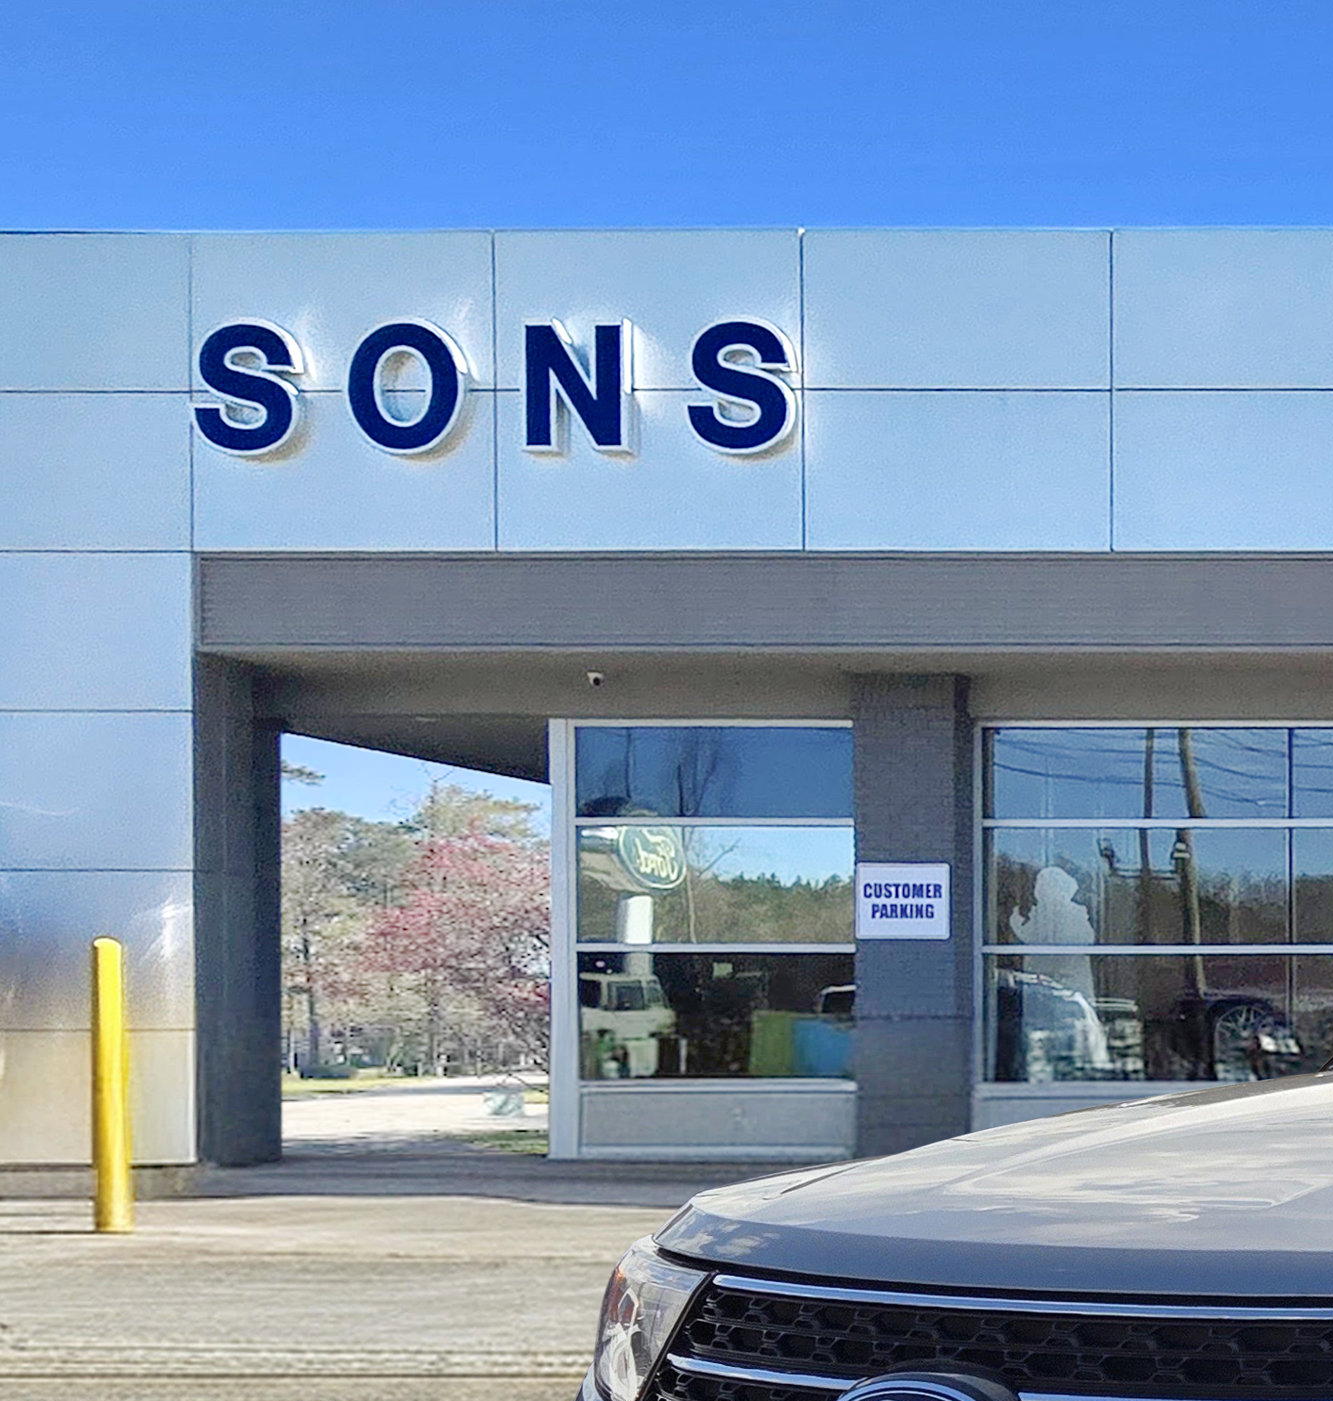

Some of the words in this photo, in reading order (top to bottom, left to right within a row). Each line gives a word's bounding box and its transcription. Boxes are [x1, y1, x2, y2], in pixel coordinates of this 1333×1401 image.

[191, 319, 798, 455] SONS
[862, 882, 943, 900] CUSTOMER
[870, 902, 935, 920] PARKING
